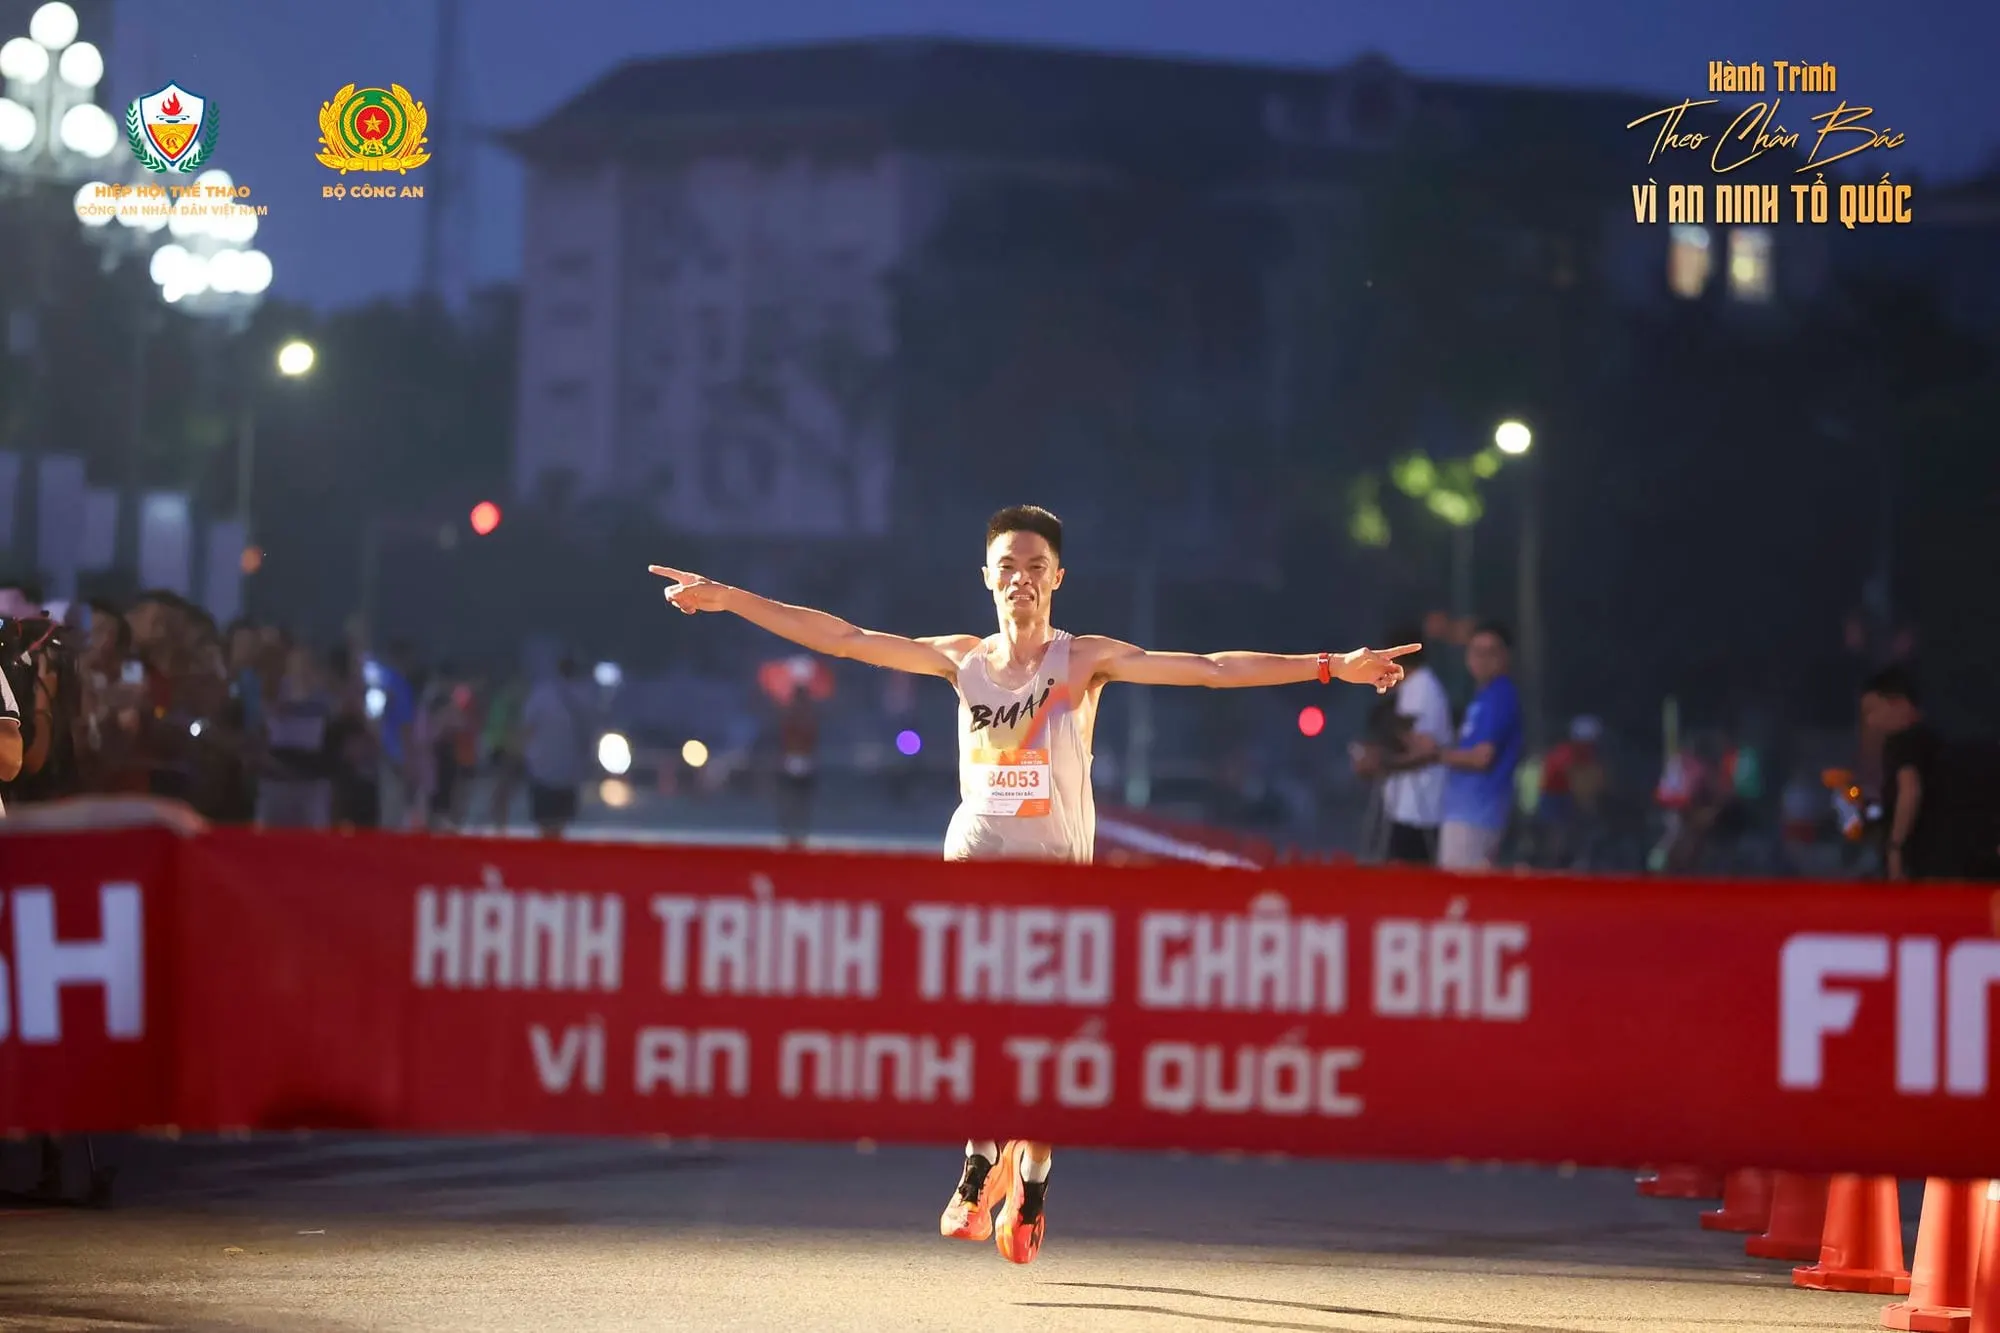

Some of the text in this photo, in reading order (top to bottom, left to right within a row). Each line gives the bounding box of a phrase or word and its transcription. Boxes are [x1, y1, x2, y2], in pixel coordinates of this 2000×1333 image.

[0, 881, 146, 1044] H
[415, 866, 623, 992] HÀNH
[651, 874, 882, 998] TRÌNH
[907, 903, 1112, 1005] THEO
[635, 1026, 748, 1096] AN
[779, 1030, 974, 1103] NINH
